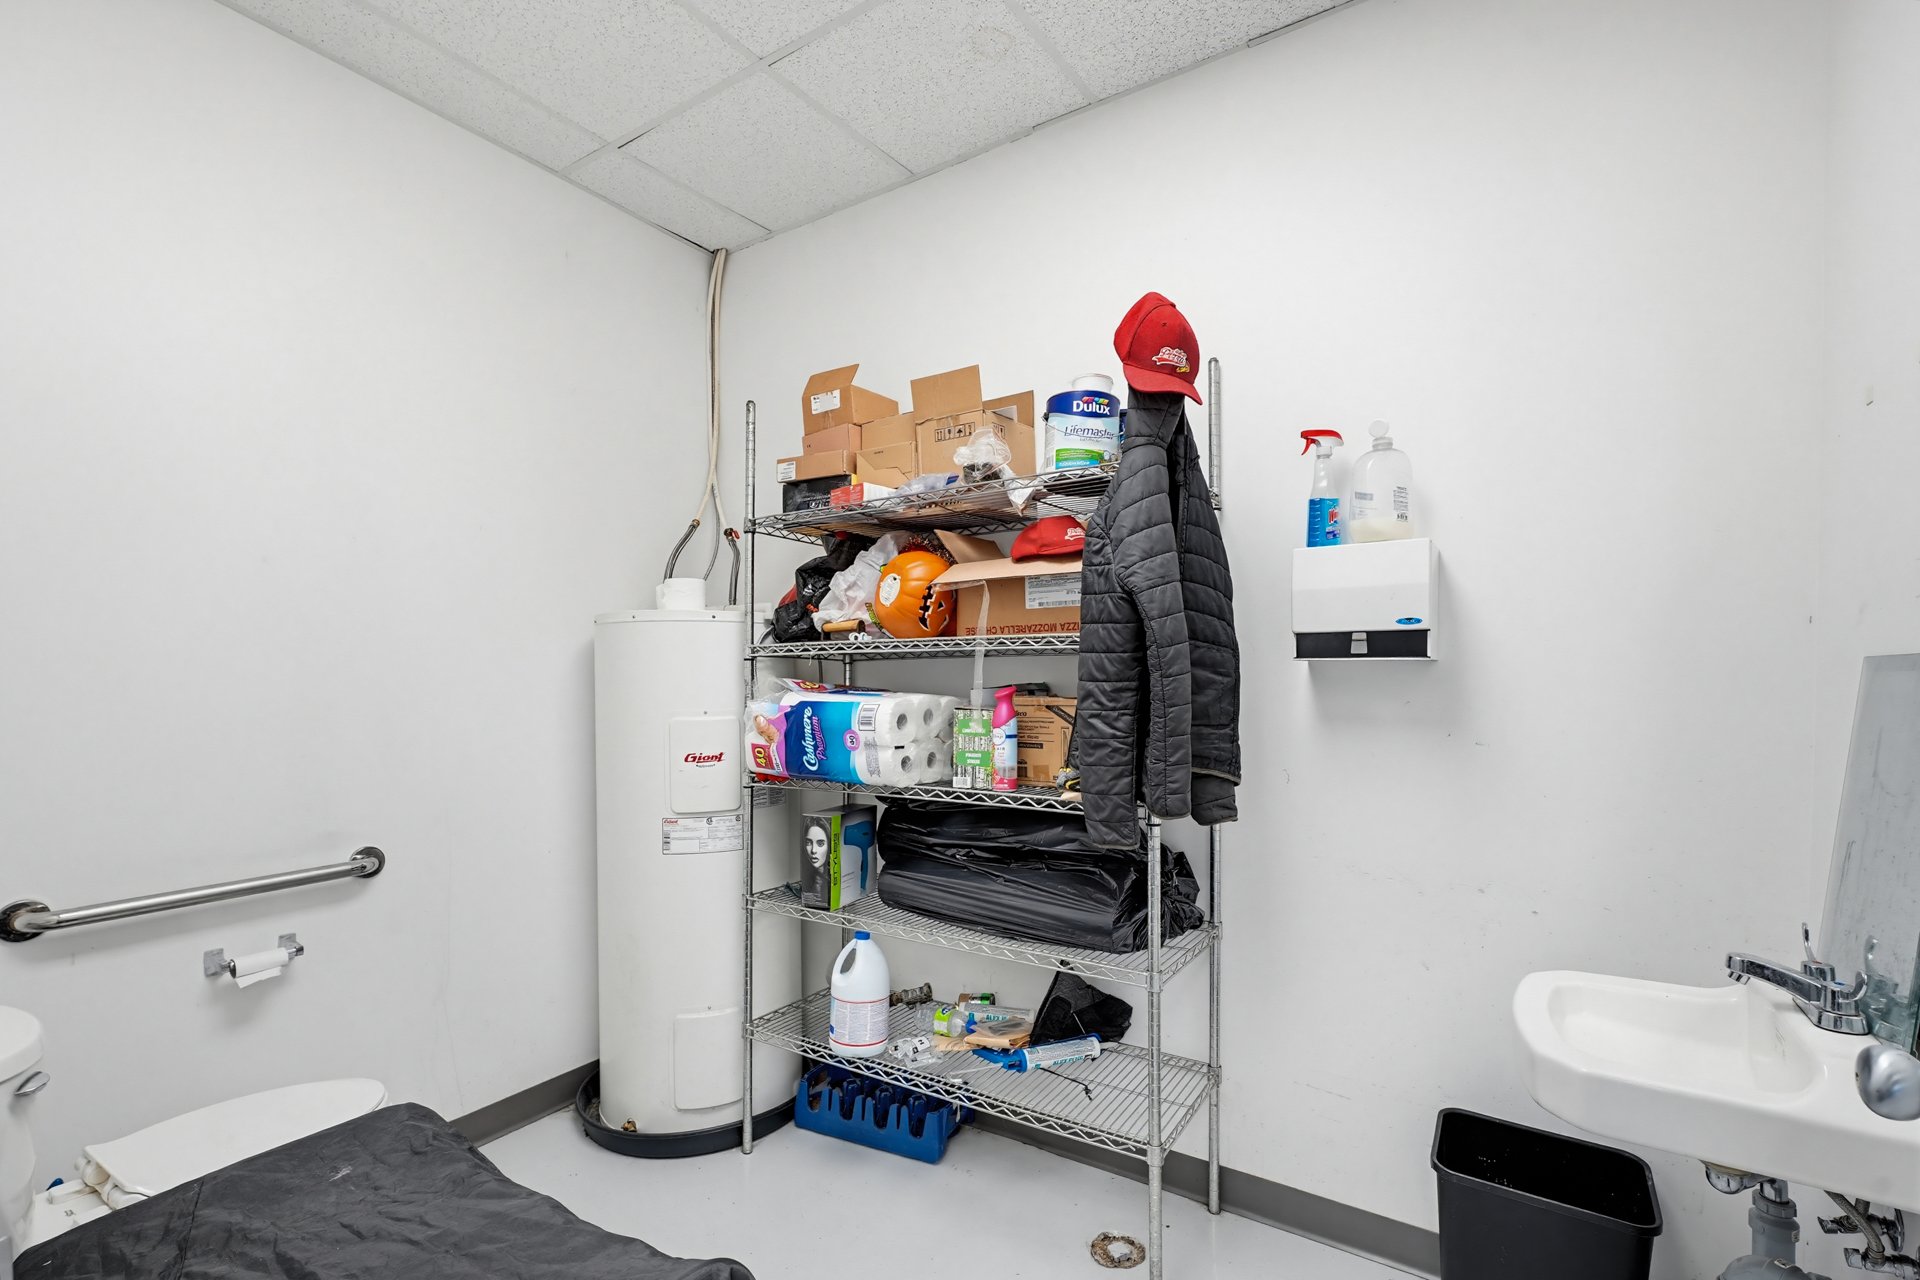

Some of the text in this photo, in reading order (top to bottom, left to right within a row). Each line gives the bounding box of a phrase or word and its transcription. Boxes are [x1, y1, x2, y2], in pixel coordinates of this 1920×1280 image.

[1072, 400, 1110, 415] Dulux
[965, 621, 1080, 636] IZZA MOZZARELLA CHSE
[801, 706, 819, 771] Cashmere
[812, 716, 827, 761] Premium
[684, 752, 725, 763] Giant
[754, 747, 766, 767] 40
